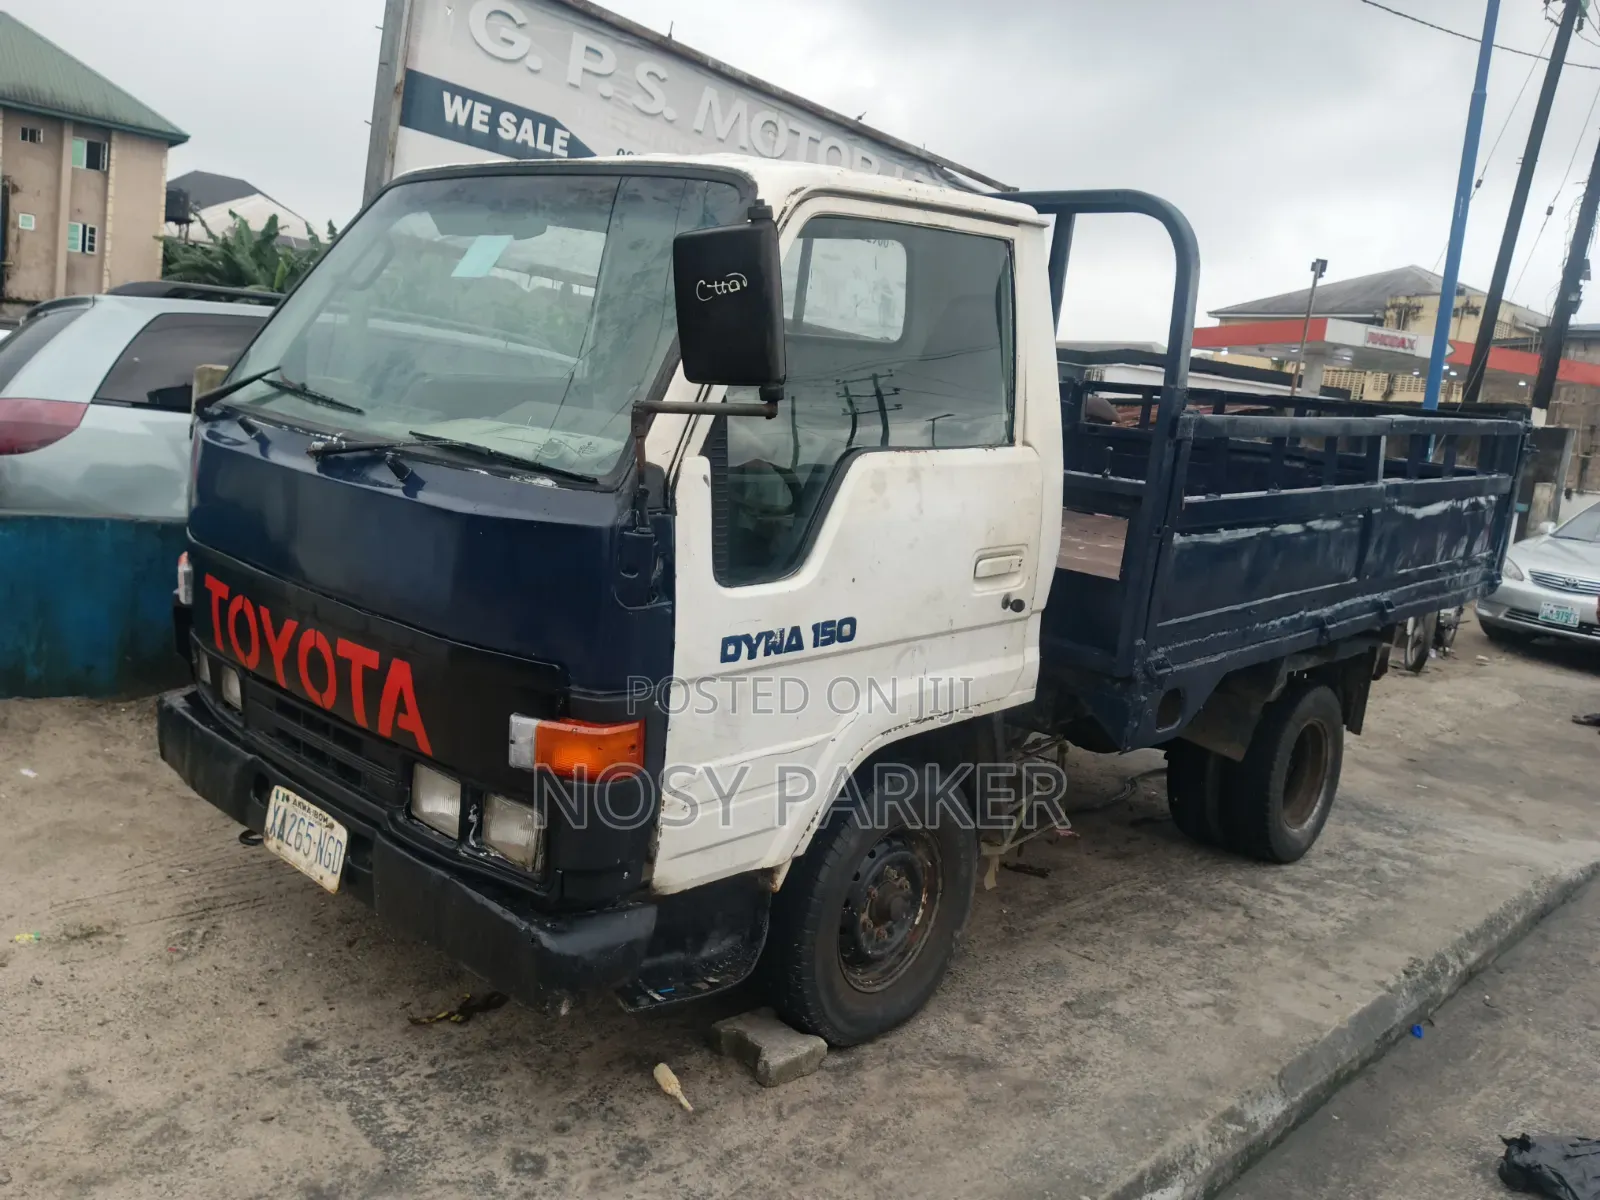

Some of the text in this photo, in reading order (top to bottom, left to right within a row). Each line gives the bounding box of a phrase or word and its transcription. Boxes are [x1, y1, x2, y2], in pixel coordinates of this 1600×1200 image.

[442, 90, 571, 158] WE SALE
[204, 572, 433, 757] TOYOTA
[720, 616, 857, 664] DYNA 150
